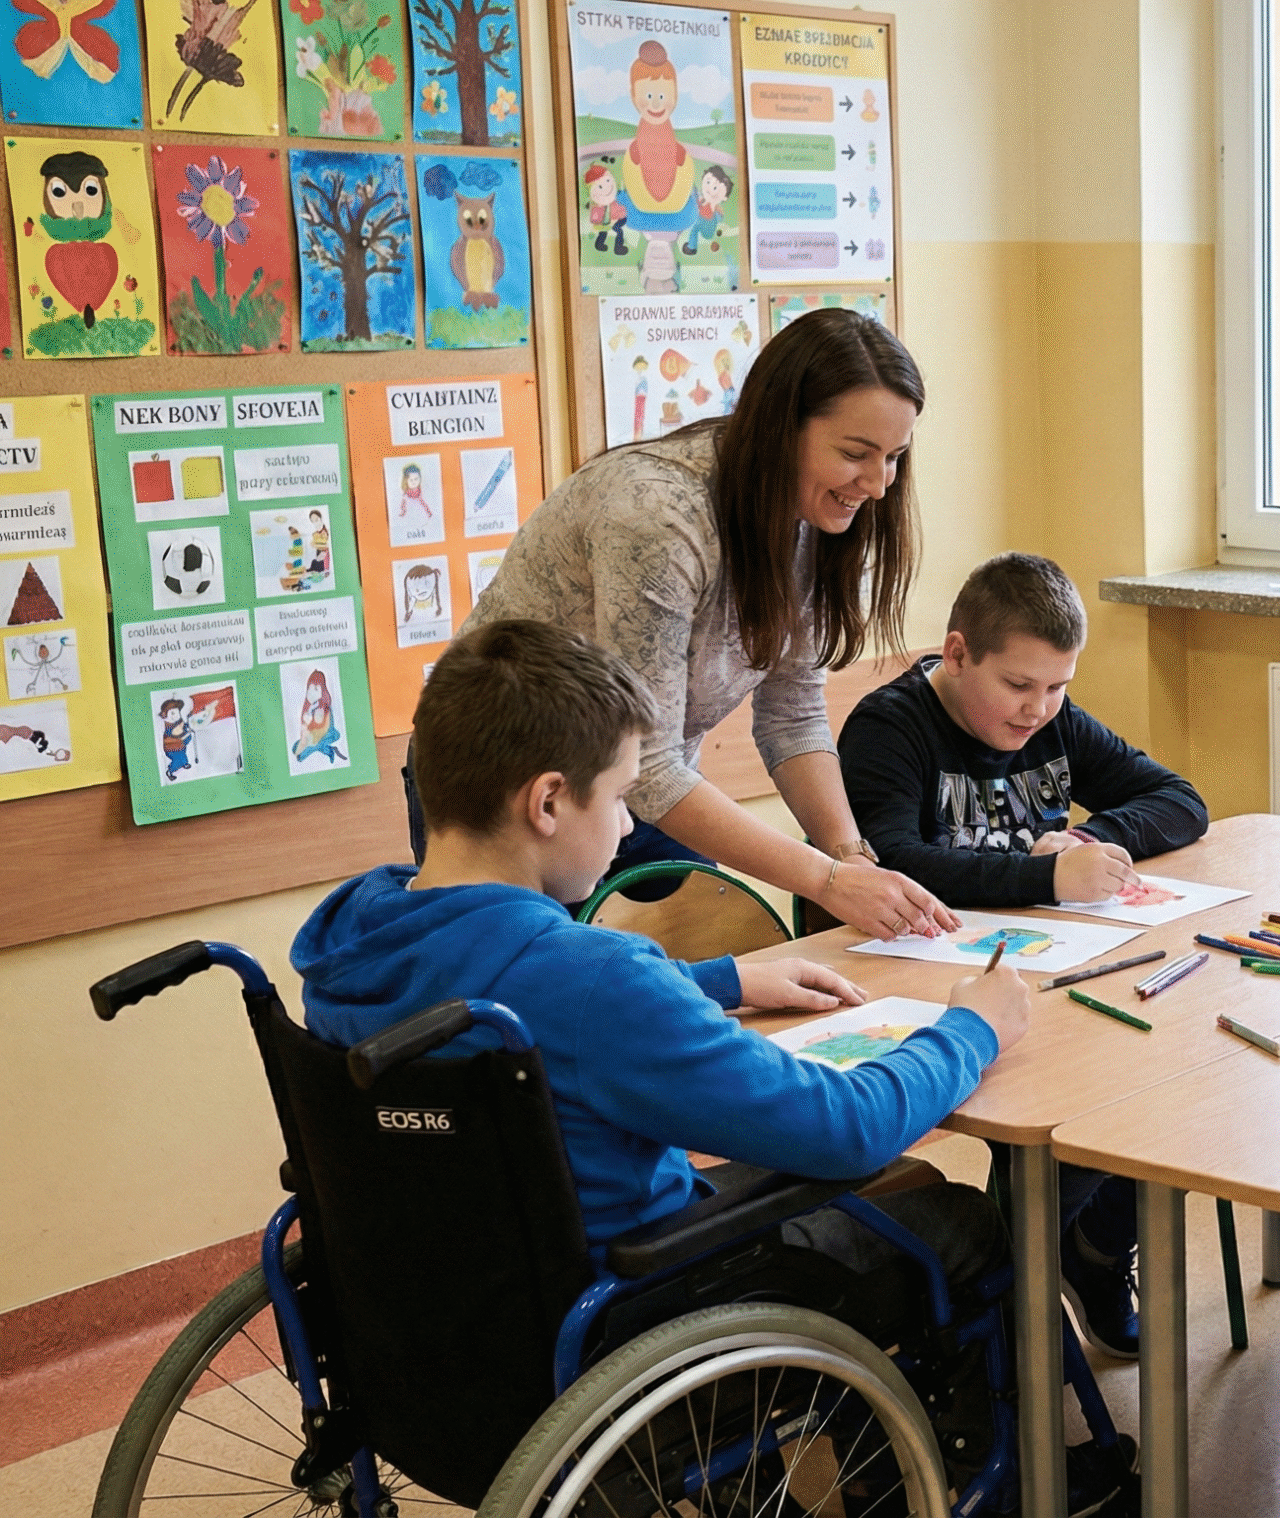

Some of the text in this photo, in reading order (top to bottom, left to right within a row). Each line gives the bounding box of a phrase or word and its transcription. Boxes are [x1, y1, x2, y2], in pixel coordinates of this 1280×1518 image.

[120, 405, 221, 425] NEK BONY
[377, 1110, 450, 1130] EOS R6
